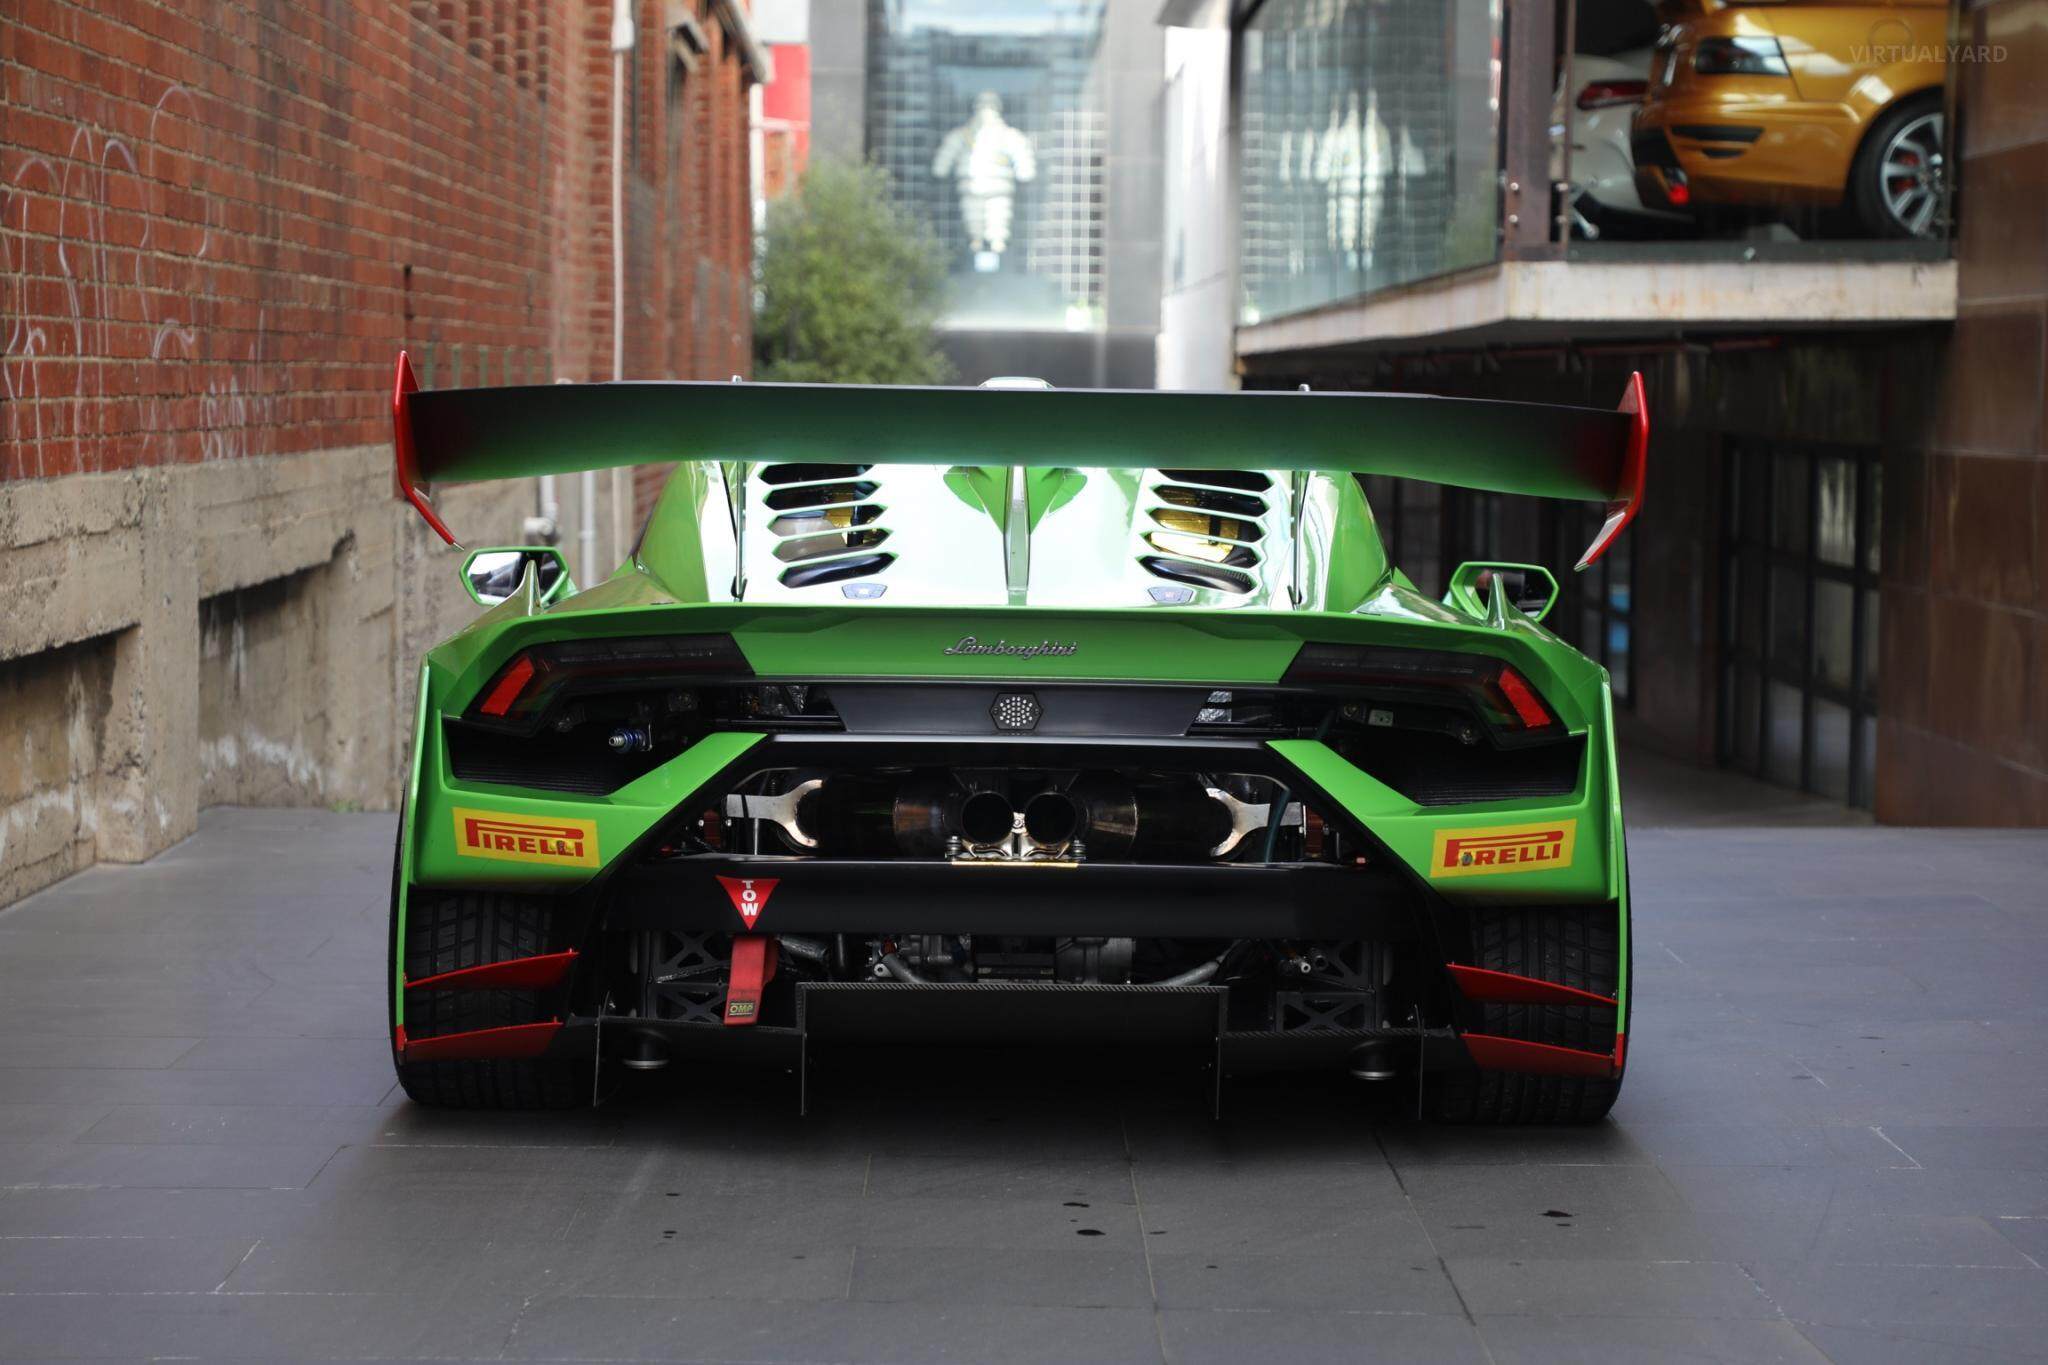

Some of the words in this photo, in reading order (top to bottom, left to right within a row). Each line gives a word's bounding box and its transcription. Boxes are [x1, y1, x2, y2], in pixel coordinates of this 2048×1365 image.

[944, 636, 1077, 660] Lamborghini
[465, 818, 584, 857] PIRELLI
[741, 880, 759, 915] TOW
